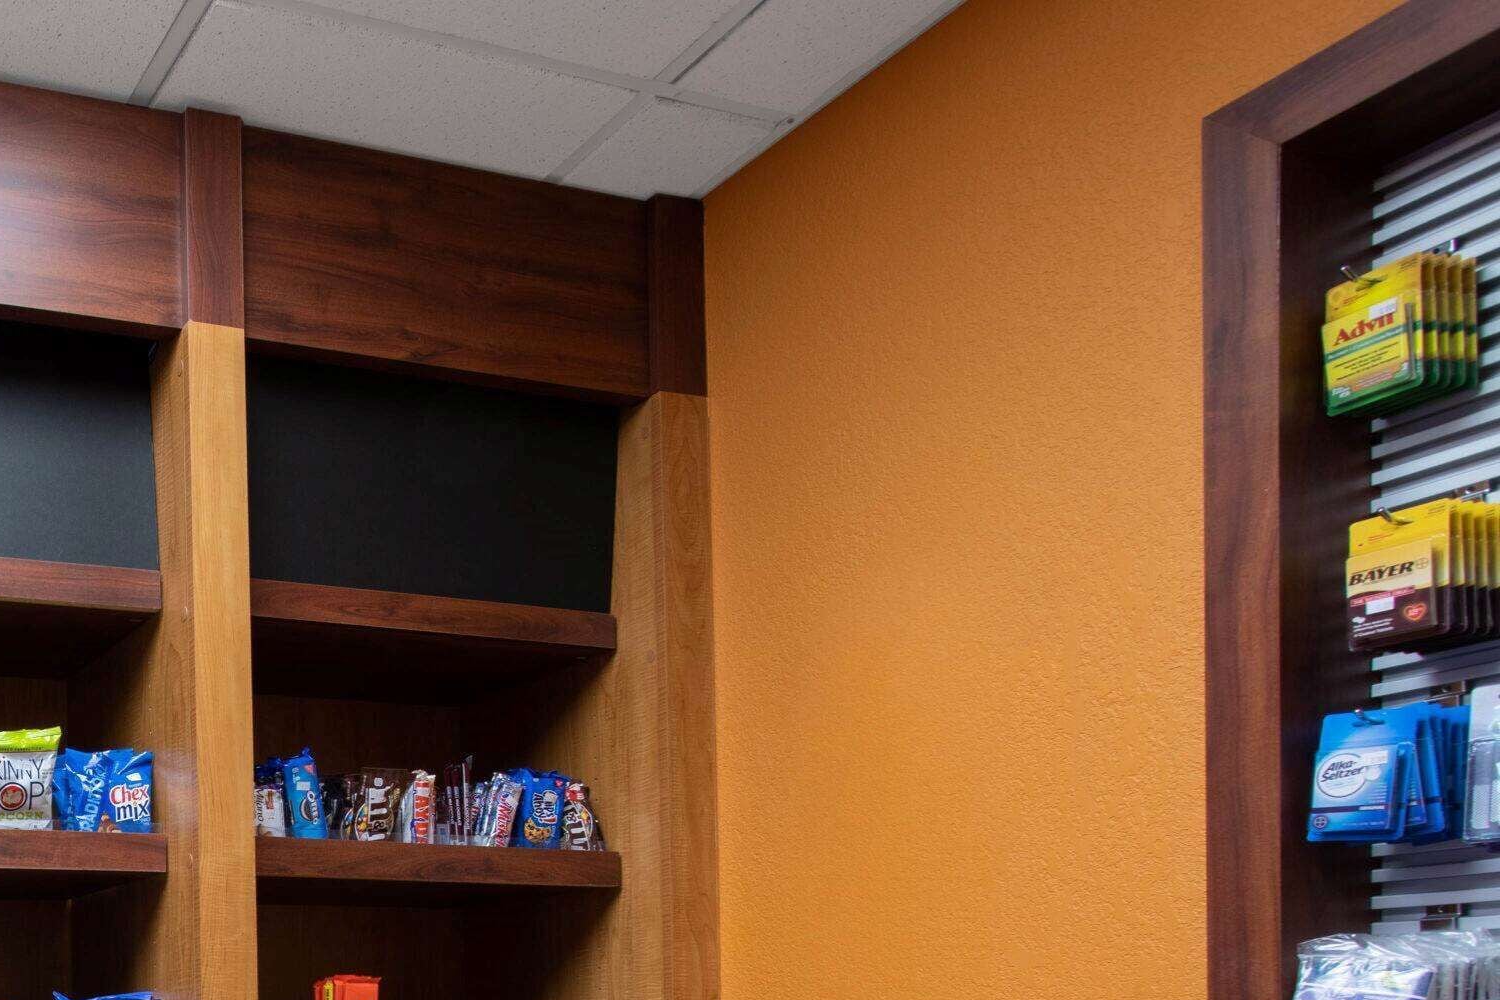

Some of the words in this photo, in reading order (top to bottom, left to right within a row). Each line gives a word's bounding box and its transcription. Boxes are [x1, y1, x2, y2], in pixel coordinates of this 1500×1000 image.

[1333, 313, 1395, 346] Advil
[1349, 561, 1414, 586] BAYER
[1320, 767, 1363, 782] Seltzer
[1326, 760, 1357, 773] Alka-
[109, 784, 149, 806] Chex
